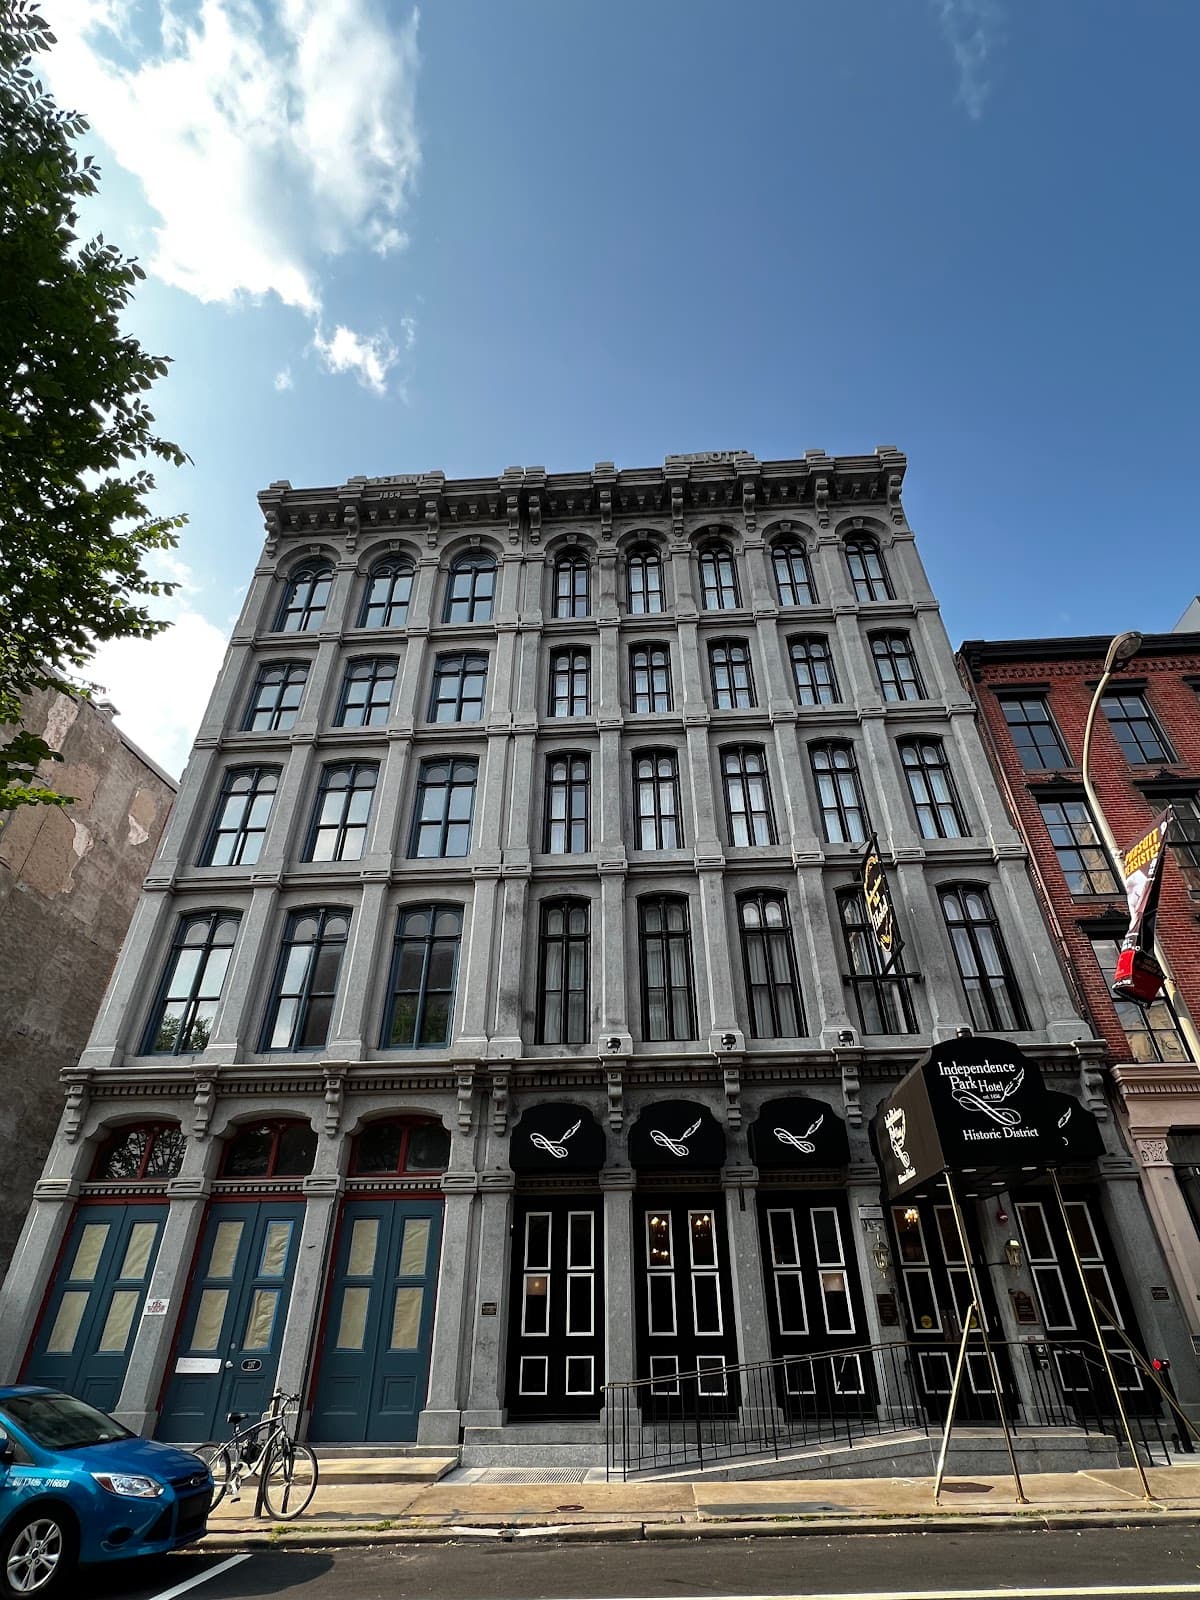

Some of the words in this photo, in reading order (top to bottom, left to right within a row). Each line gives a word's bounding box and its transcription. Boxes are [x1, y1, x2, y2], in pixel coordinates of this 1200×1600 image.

[937, 1059, 1016, 1077] Independence
[949, 1075, 977, 1090] Park
[978, 1080, 1004, 1092] Hotel
[963, 1129, 1002, 1140] Historic
[1002, 1127, 1040, 1138] District
